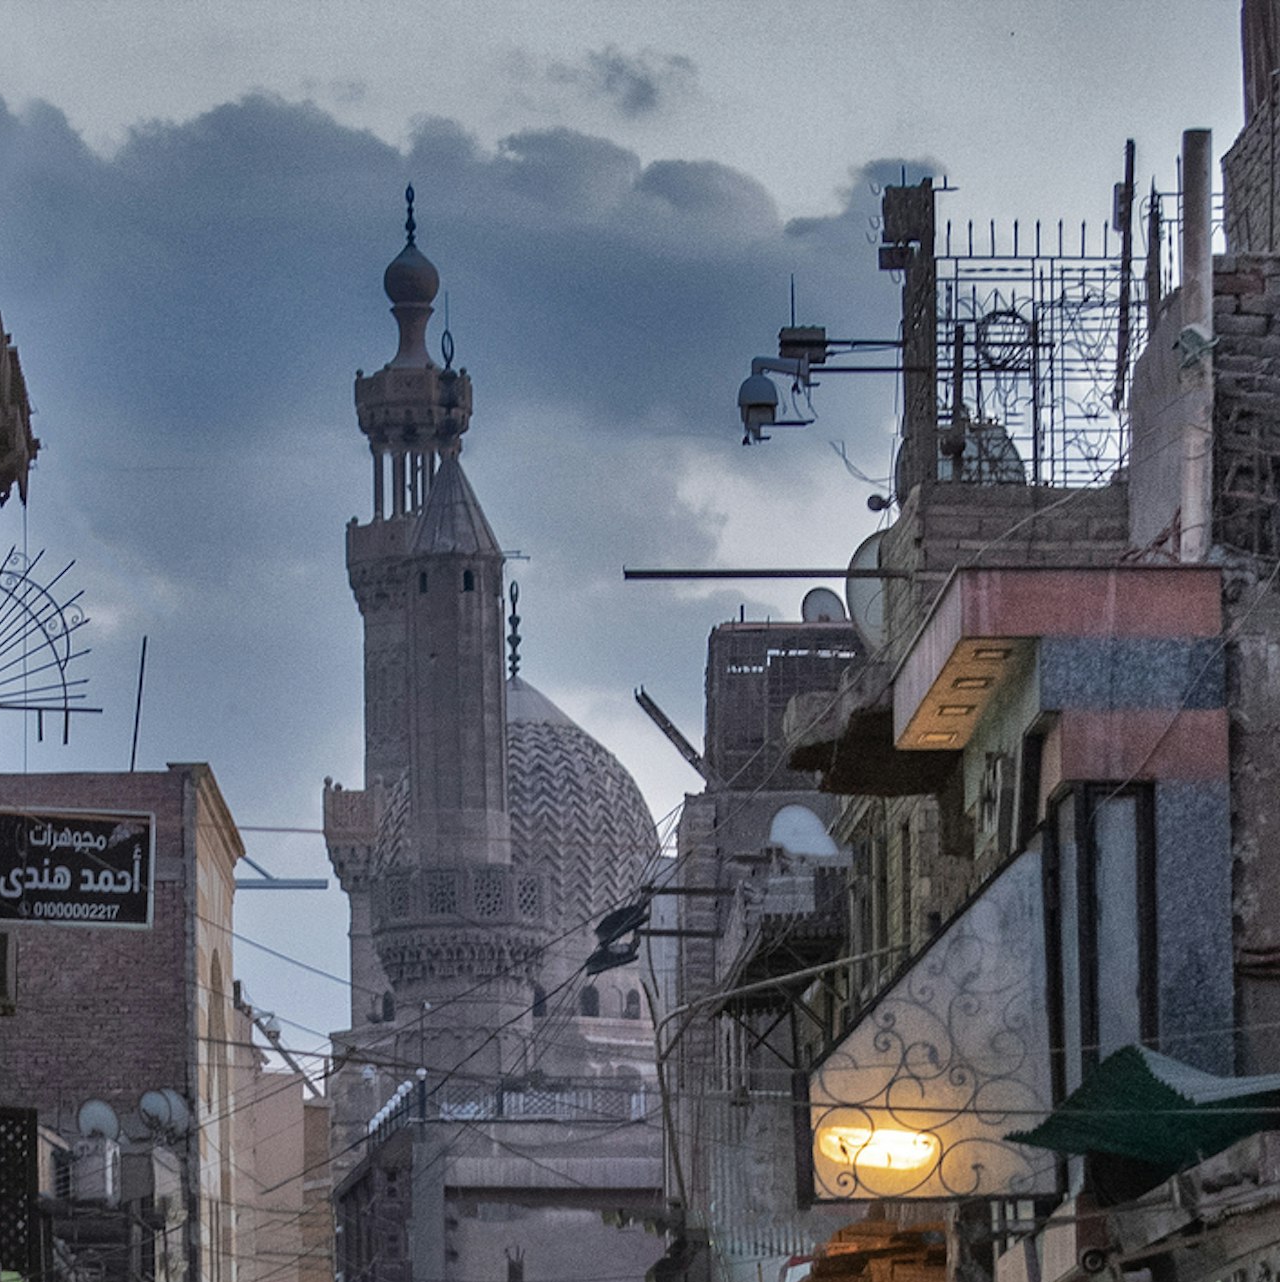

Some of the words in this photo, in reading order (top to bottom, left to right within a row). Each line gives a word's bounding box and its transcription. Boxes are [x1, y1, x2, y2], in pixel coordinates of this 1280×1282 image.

[28, 822, 107, 853] مجوهرات
[79, 843, 142, 894] أحمد
[33, 901, 120, 919] 01000002217
